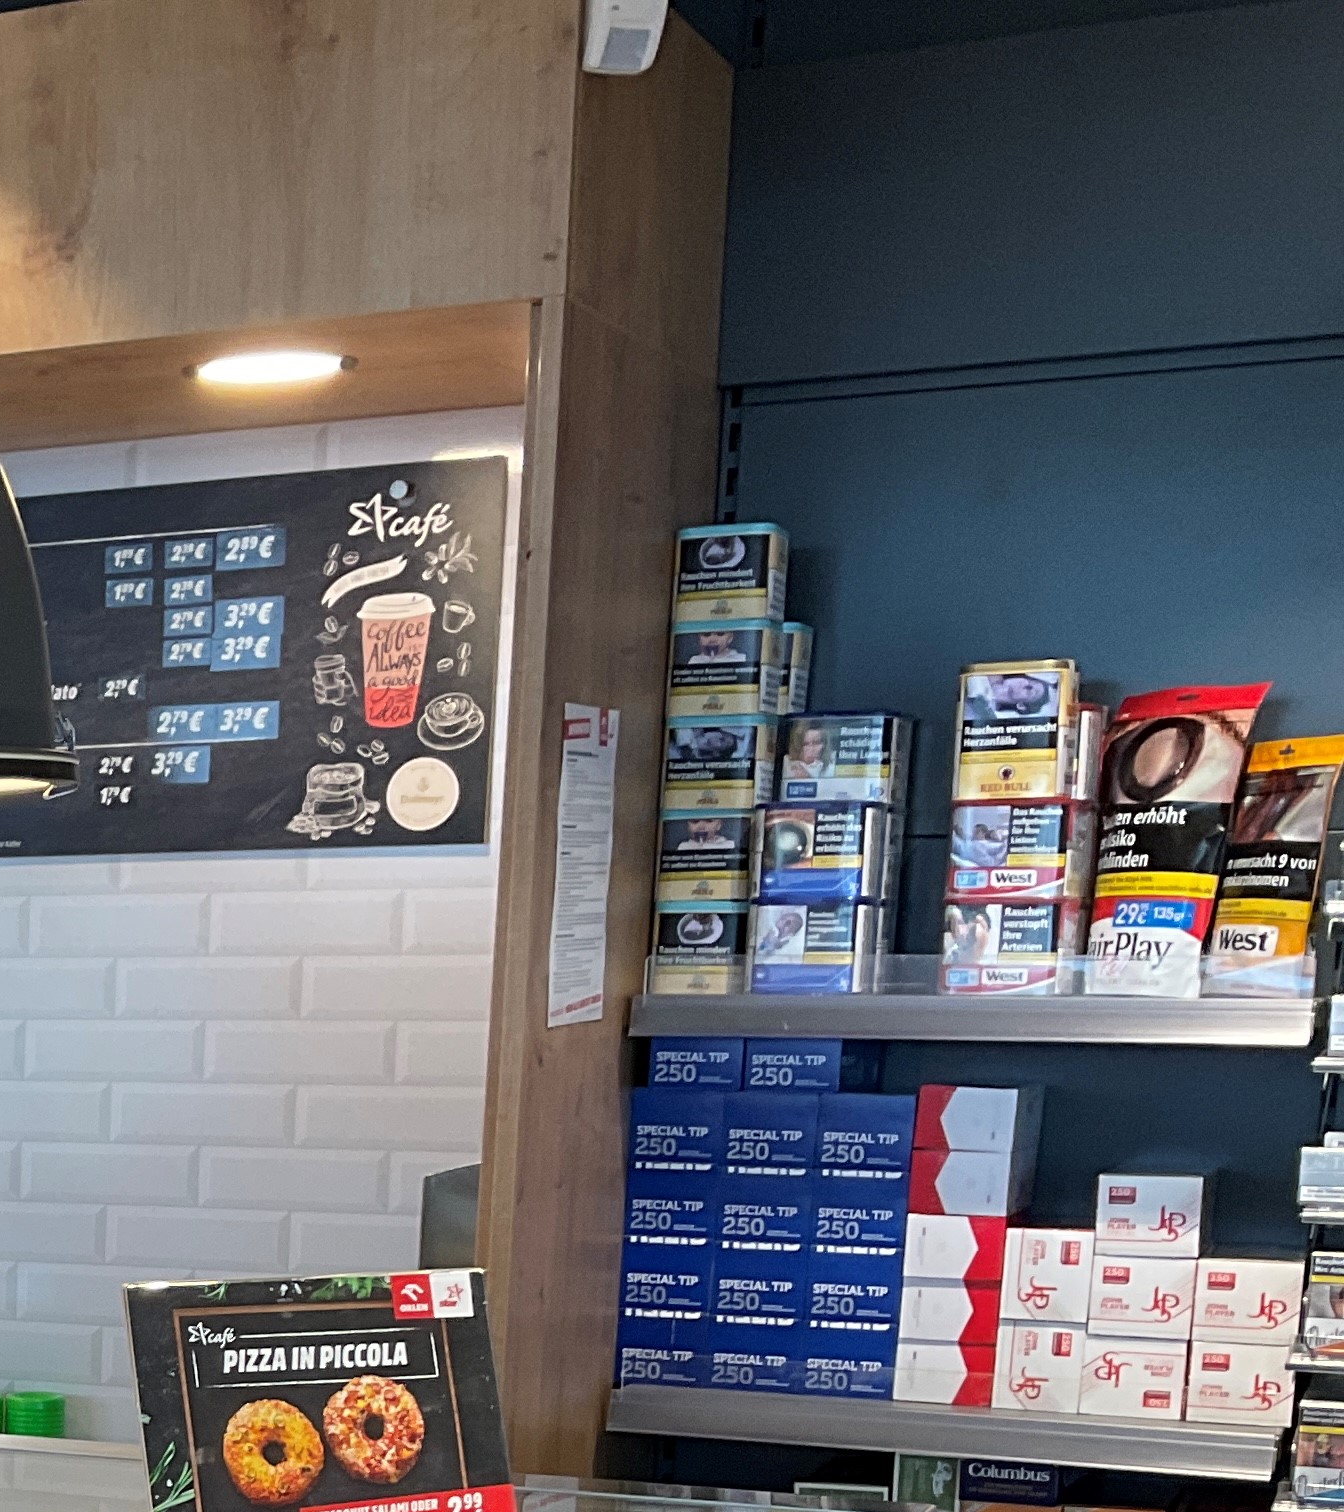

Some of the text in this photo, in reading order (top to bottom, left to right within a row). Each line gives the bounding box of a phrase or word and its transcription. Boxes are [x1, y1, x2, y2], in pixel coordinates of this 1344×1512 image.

[1005, 783, 1031, 792] BULL
[995, 872, 1032, 885] West
[1219, 928, 1266, 952] West
[656, 1052, 729, 1063] SPECIAL TIP
[654, 1064, 696, 1082] 250
[824, 1132, 899, 1144] SPECIAL TIP
[821, 1145, 864, 1163] 250
[223, 1342, 408, 1373] PIZZA IN PICCOLA
[968, 1463, 1050, 1482] Columbus
